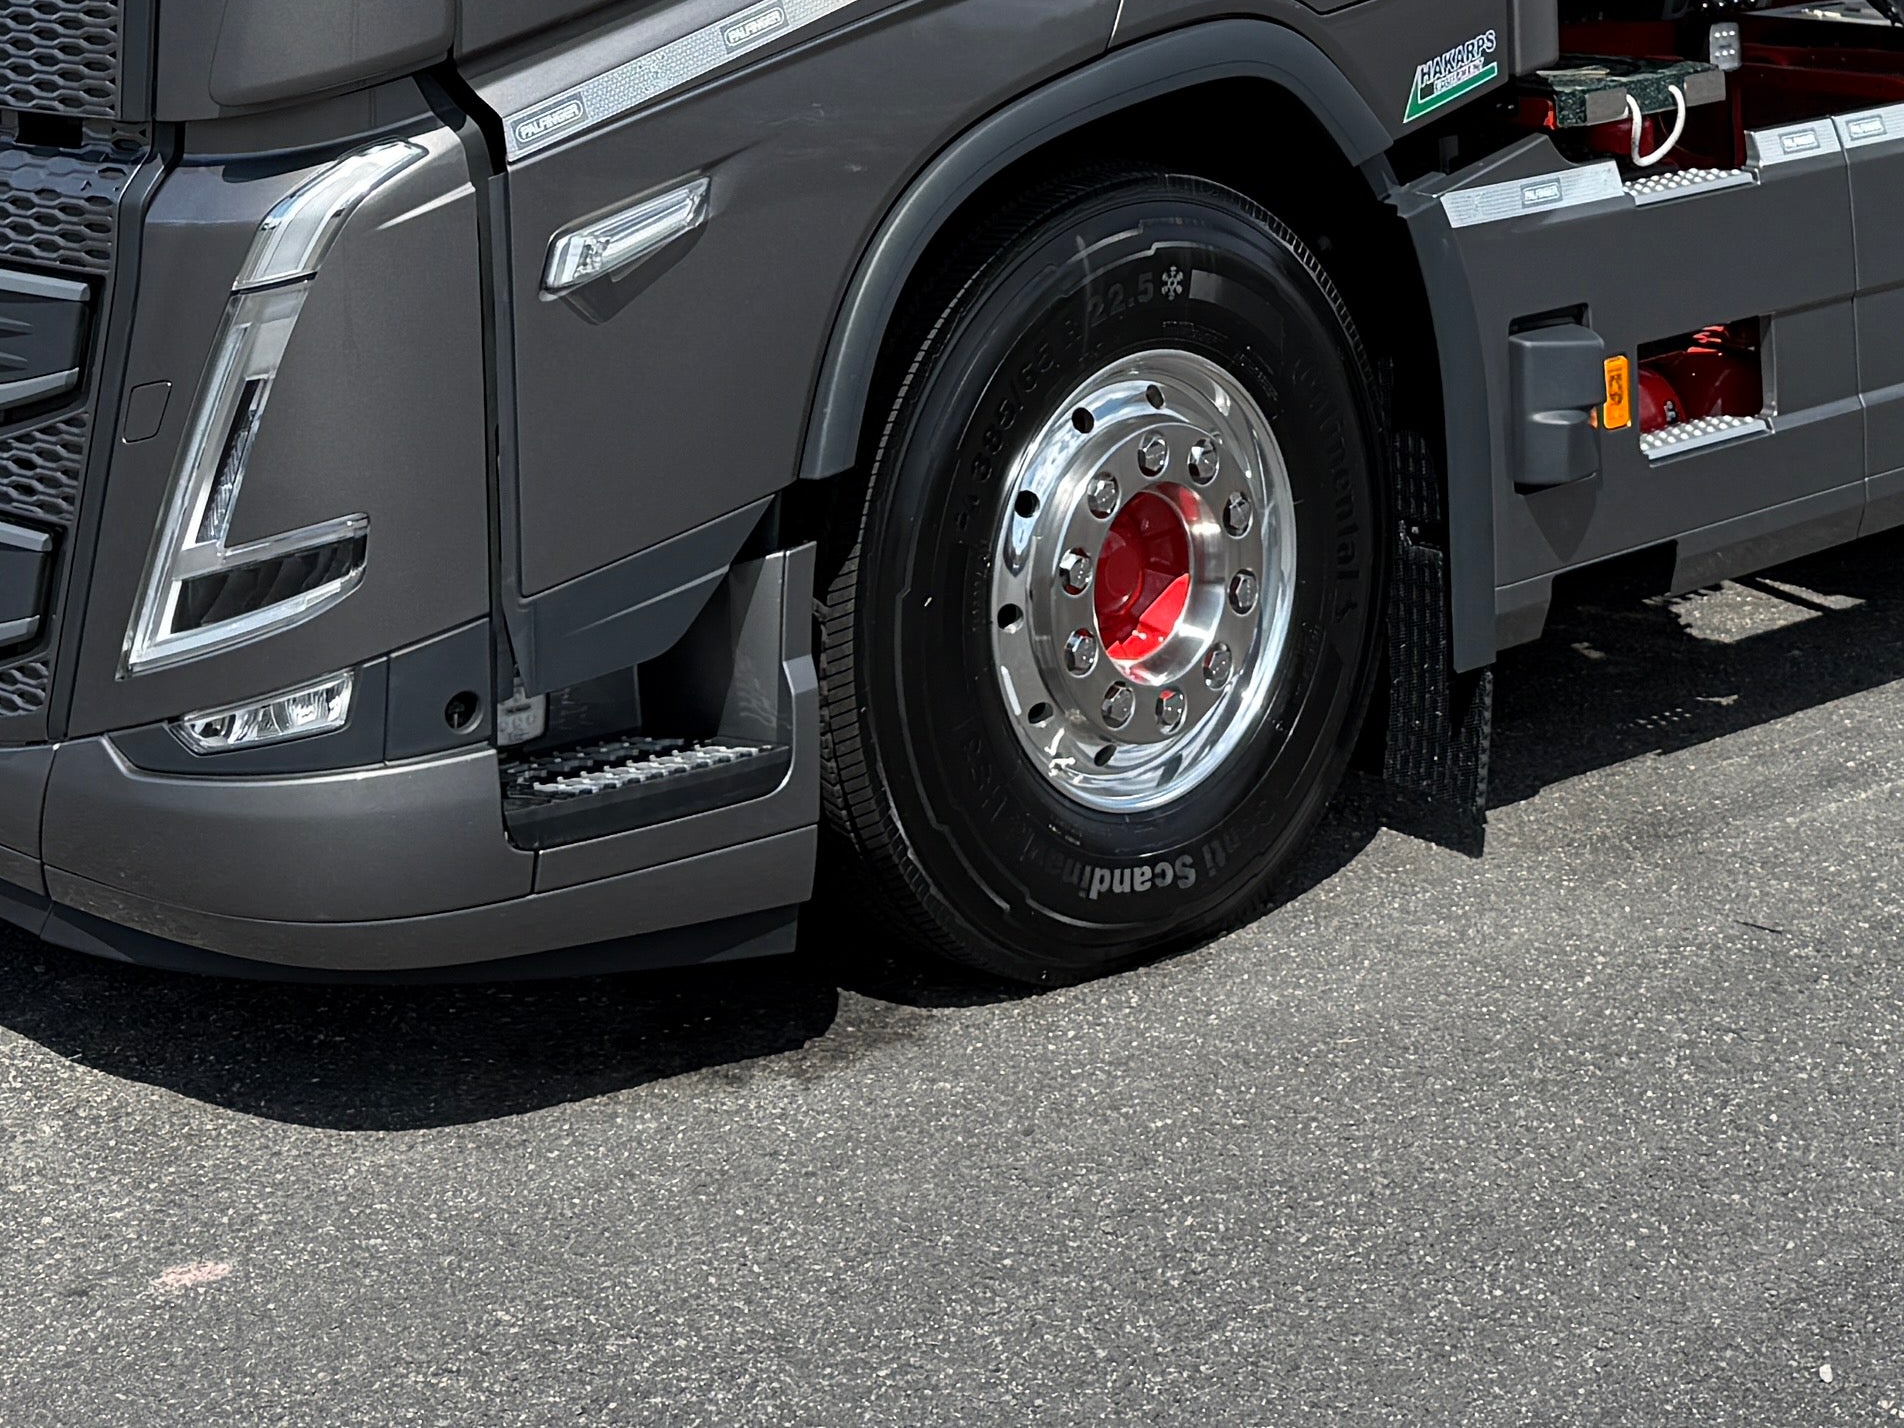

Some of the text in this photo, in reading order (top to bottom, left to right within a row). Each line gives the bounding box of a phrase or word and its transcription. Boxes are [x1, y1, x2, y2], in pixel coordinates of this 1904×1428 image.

[1418, 29, 1497, 88] HAKARPS
[519, 103, 580, 140] PALFINGER
[1089, 272, 1155, 327] 22.5
